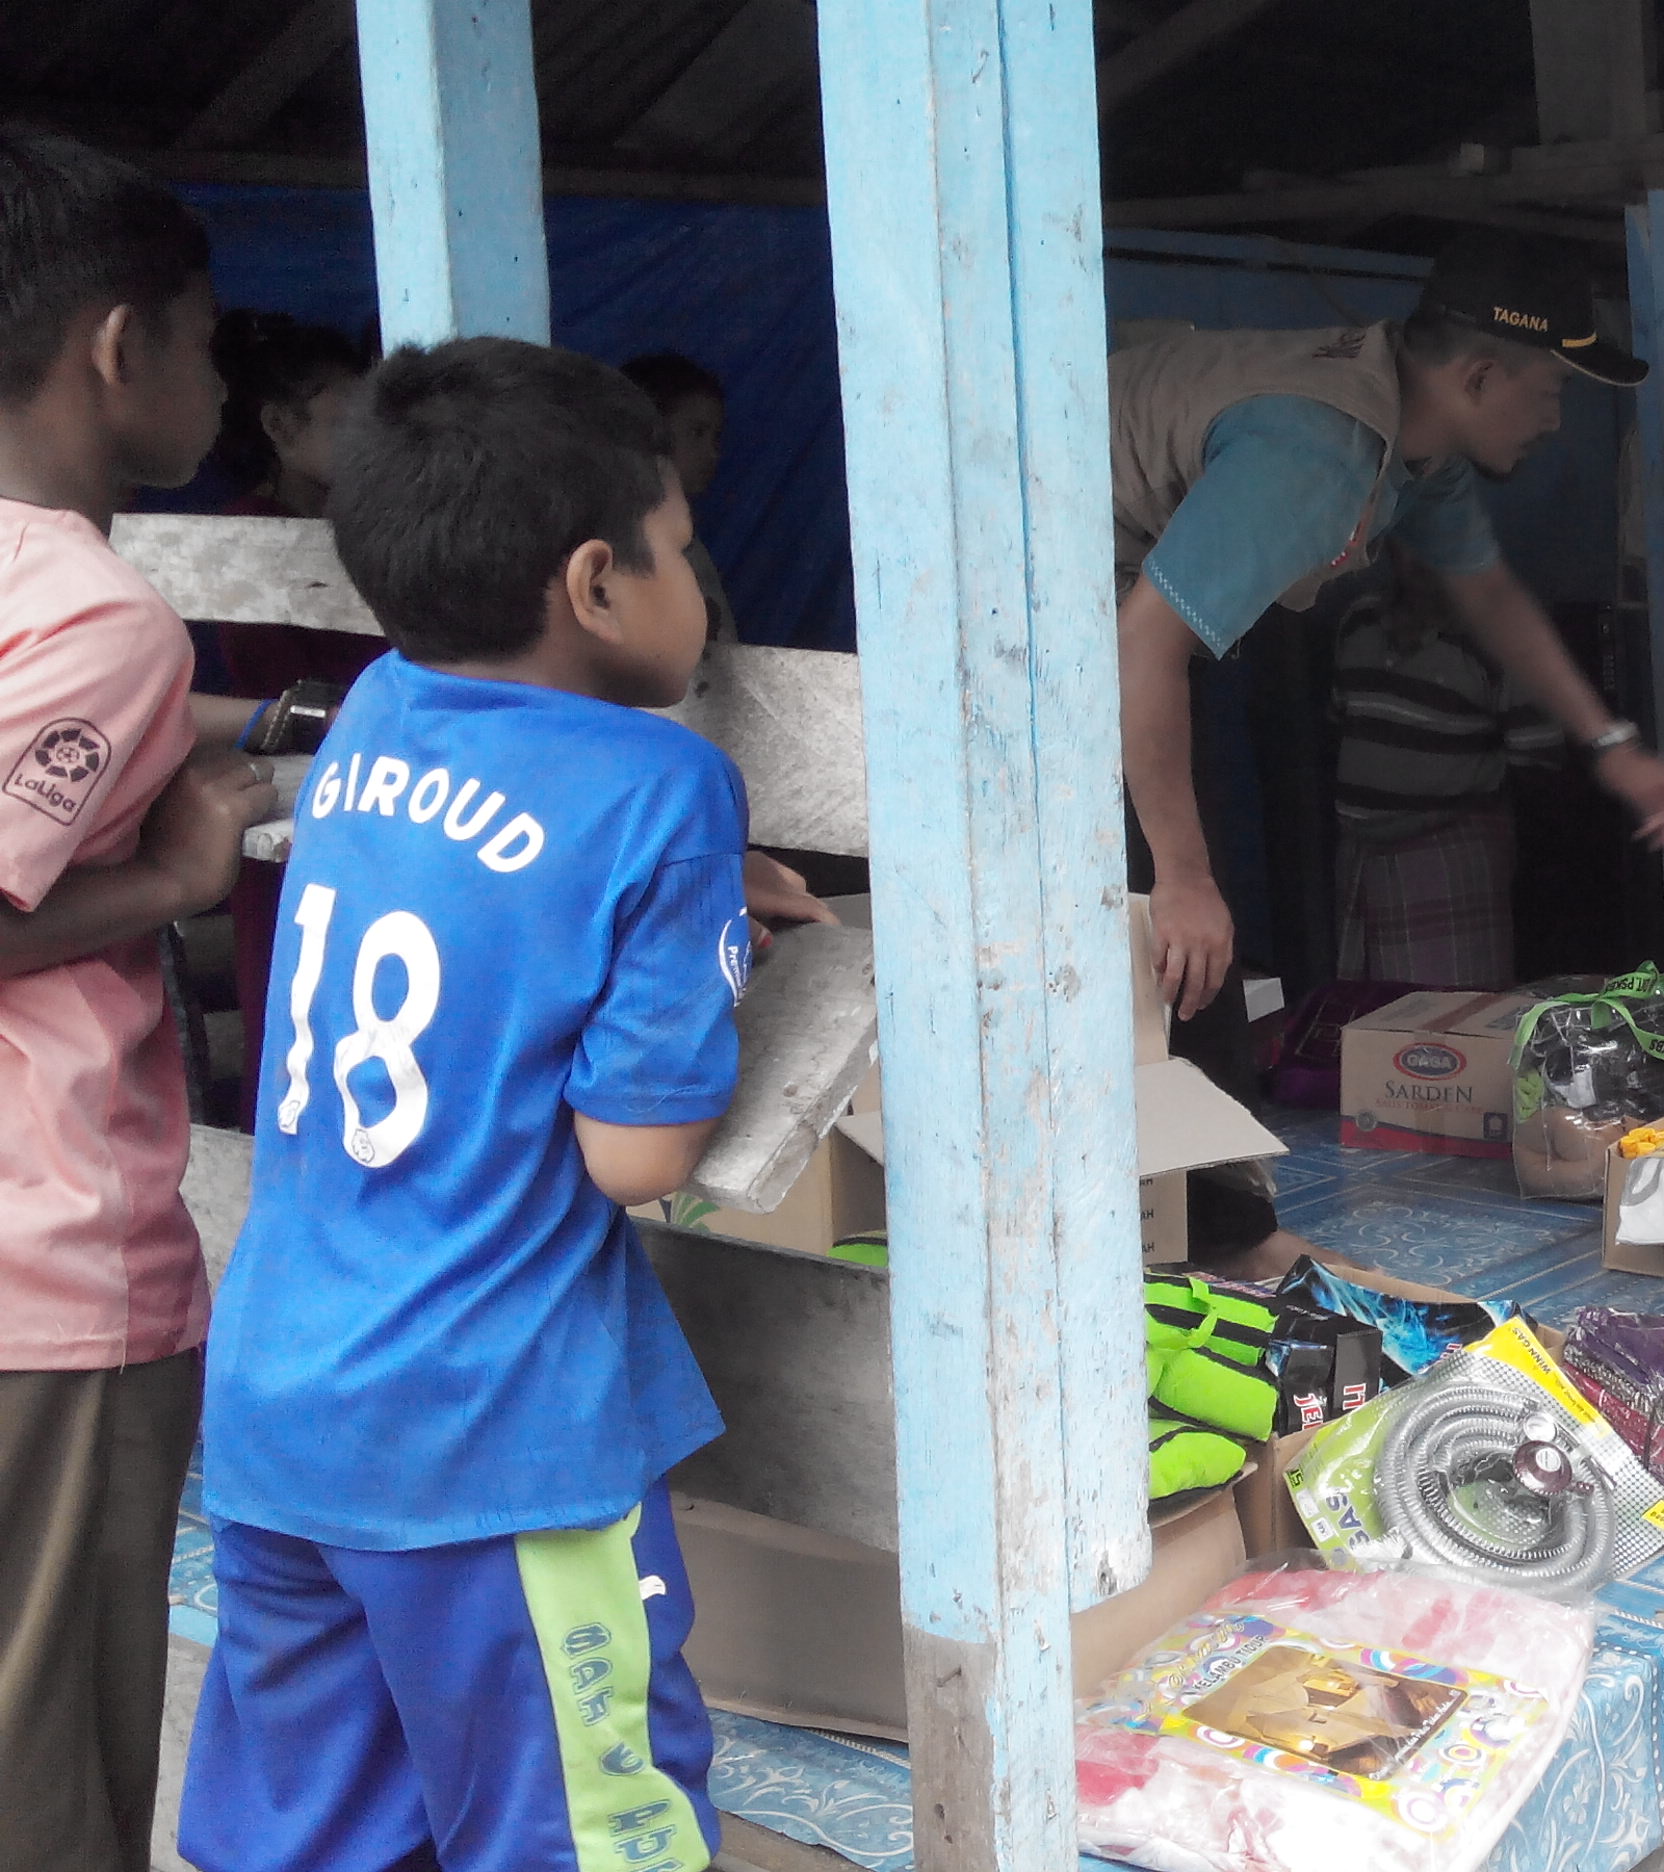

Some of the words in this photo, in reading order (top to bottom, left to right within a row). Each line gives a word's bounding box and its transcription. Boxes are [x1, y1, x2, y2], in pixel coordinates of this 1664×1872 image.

[1493, 305, 1549, 332] TAGANA
[310, 752, 546, 873] GIROUD
[275, 882, 442, 1169] 18
[1385, 1079, 1473, 1104] SARDEN
